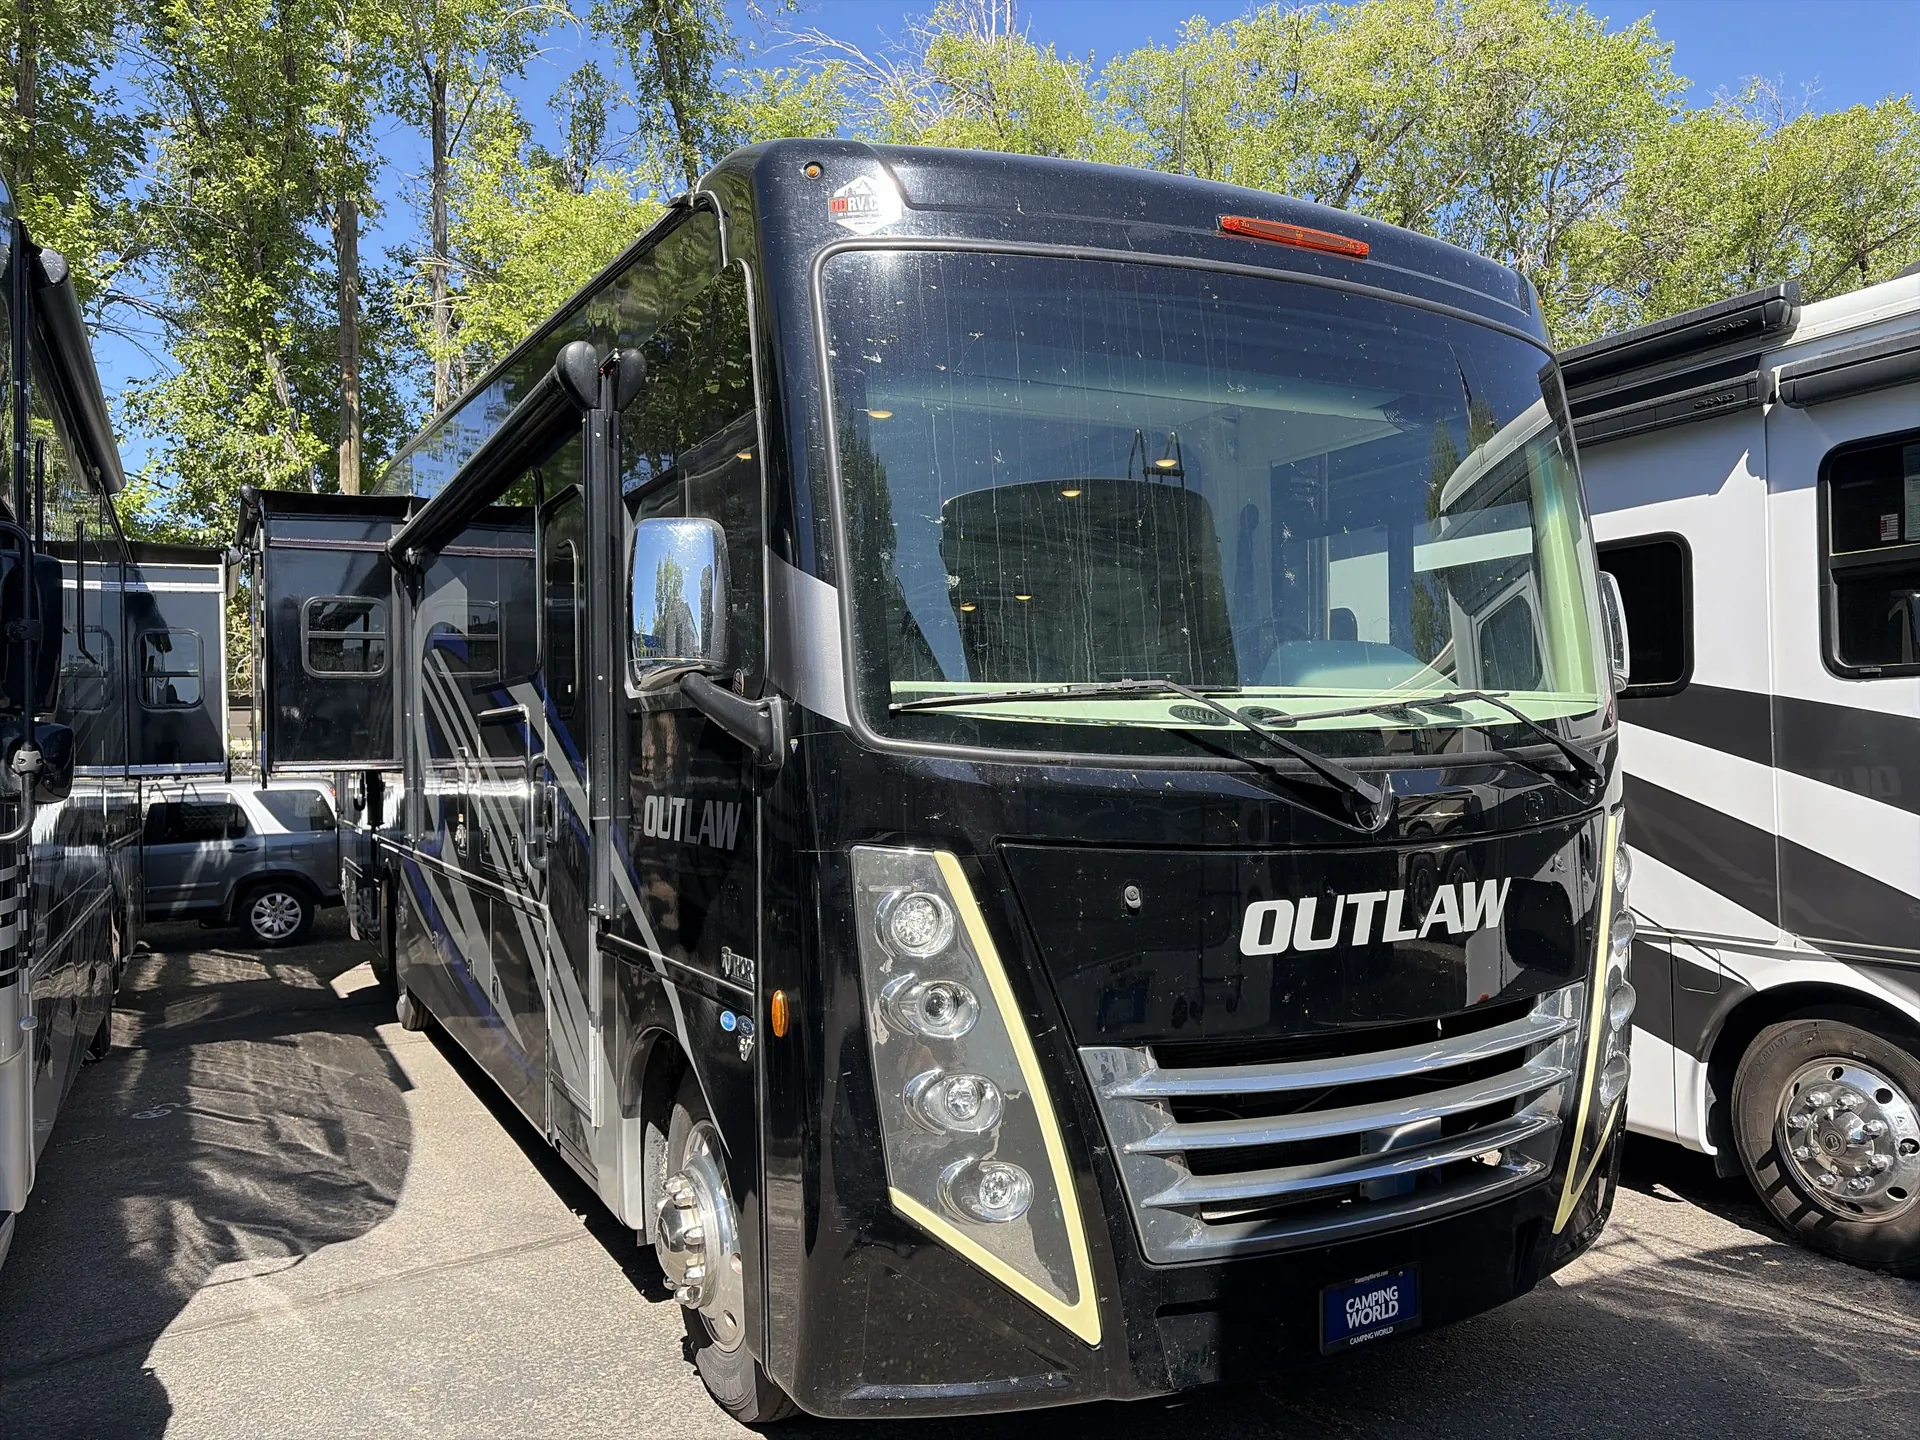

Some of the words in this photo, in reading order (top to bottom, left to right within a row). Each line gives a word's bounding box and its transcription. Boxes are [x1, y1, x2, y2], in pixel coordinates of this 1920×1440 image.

[643, 795, 742, 851] OUTLAW
[1239, 876, 1511, 957] OUTLAW
[1345, 1285, 1399, 1313] CAMPING
[1346, 1300, 1399, 1329] WORLD
[1349, 1331, 1375, 1345] CAMPING
[1373, 1326, 1394, 1338] WORLD
